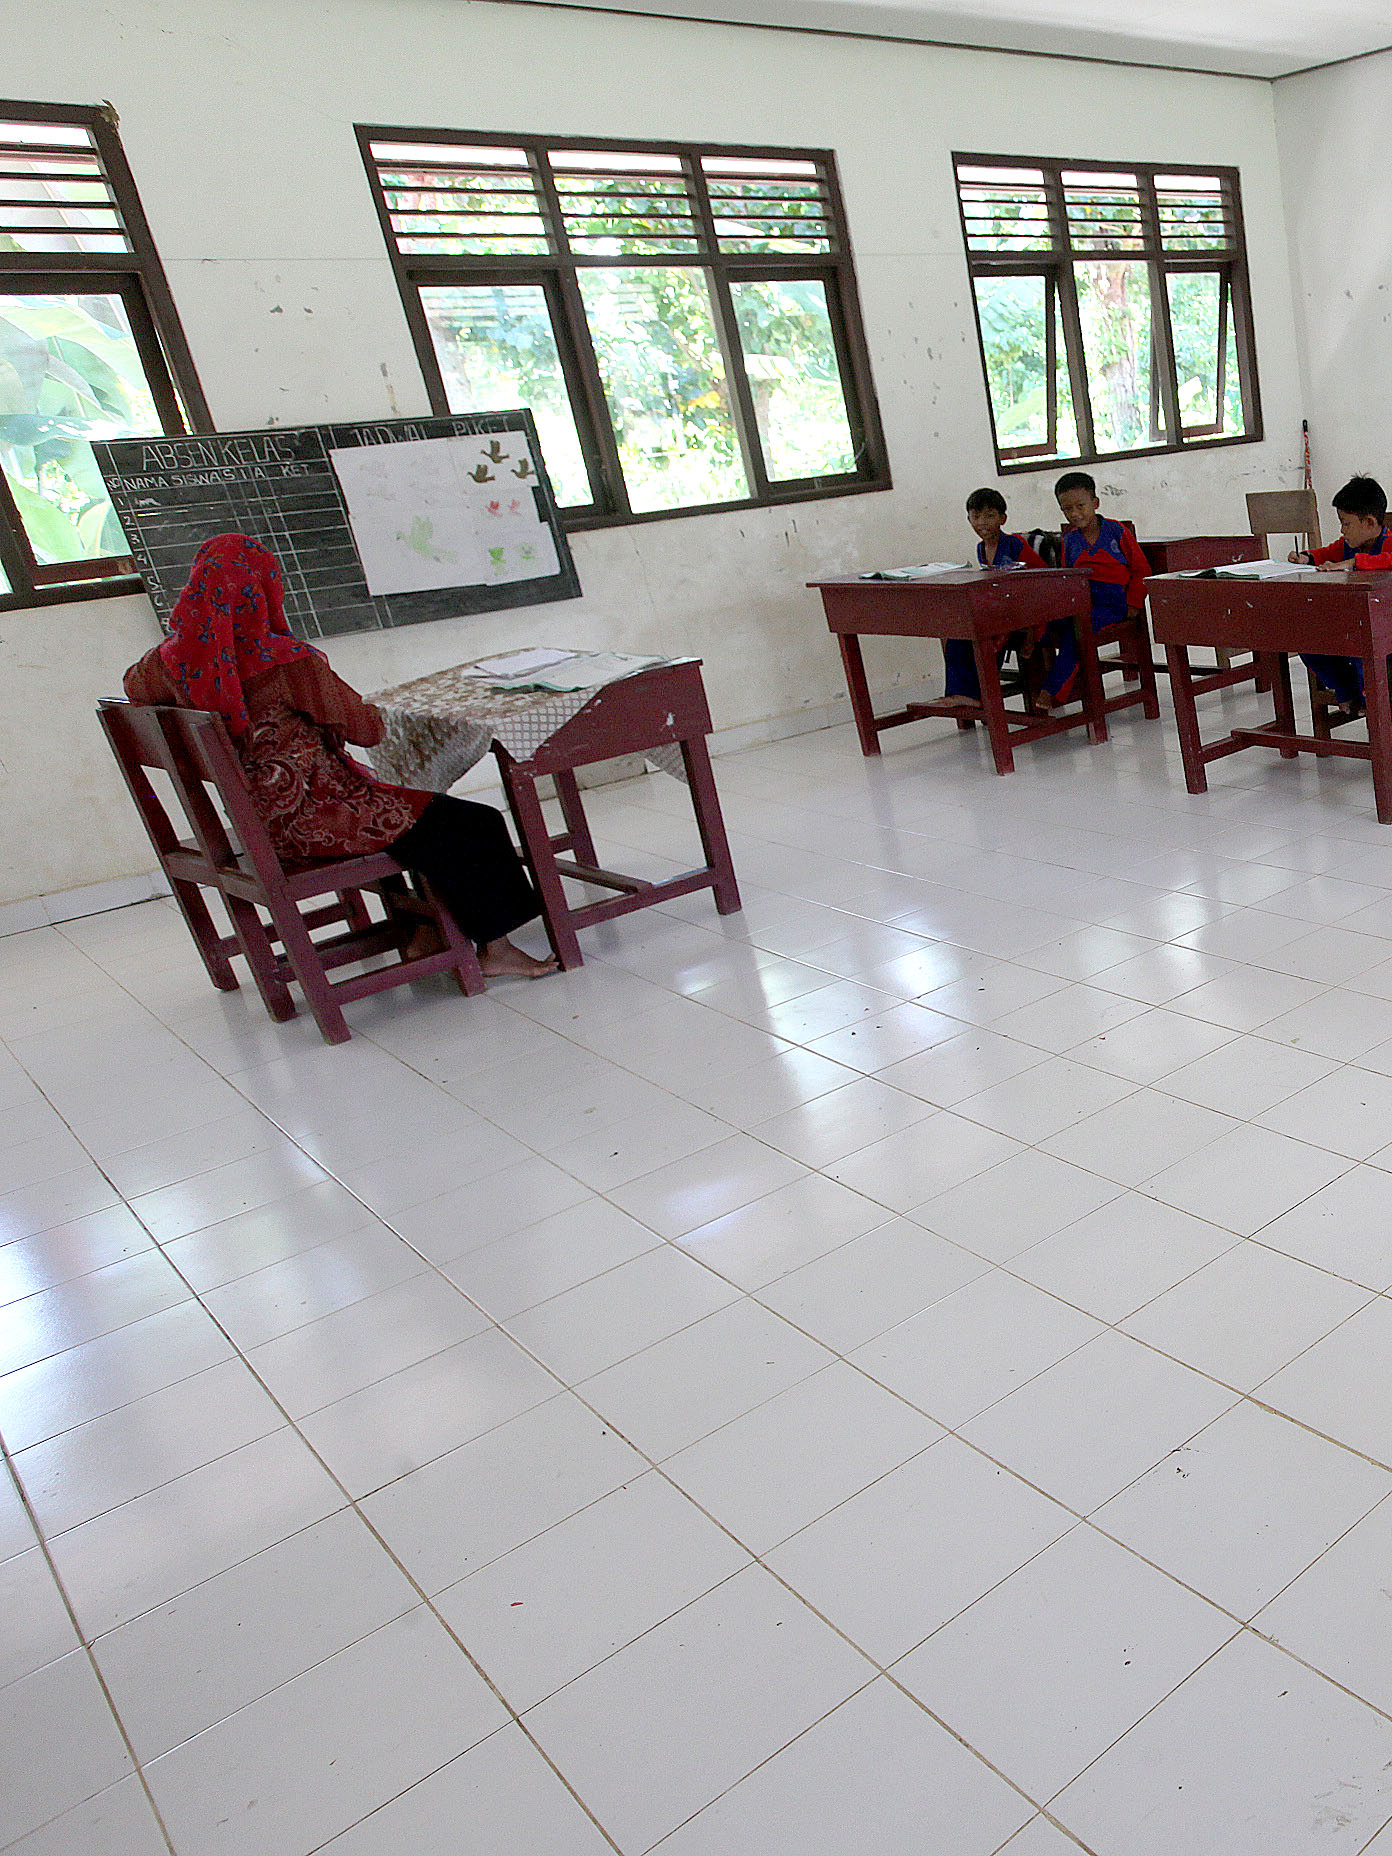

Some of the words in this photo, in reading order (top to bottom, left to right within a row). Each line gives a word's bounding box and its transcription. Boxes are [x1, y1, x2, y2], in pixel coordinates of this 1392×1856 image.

[143, 440, 219, 471] ABSEN
[217, 436, 296, 465] KELAS
[123, 475, 169, 490] NAMA
[171, 470, 222, 486] SISWA
[280, 463, 309, 477] KET
[123, 515, 135, 526] 2
[130, 533, 140, 545] 3
[137, 554, 148, 565] 4
[147, 575, 159, 591] 5
